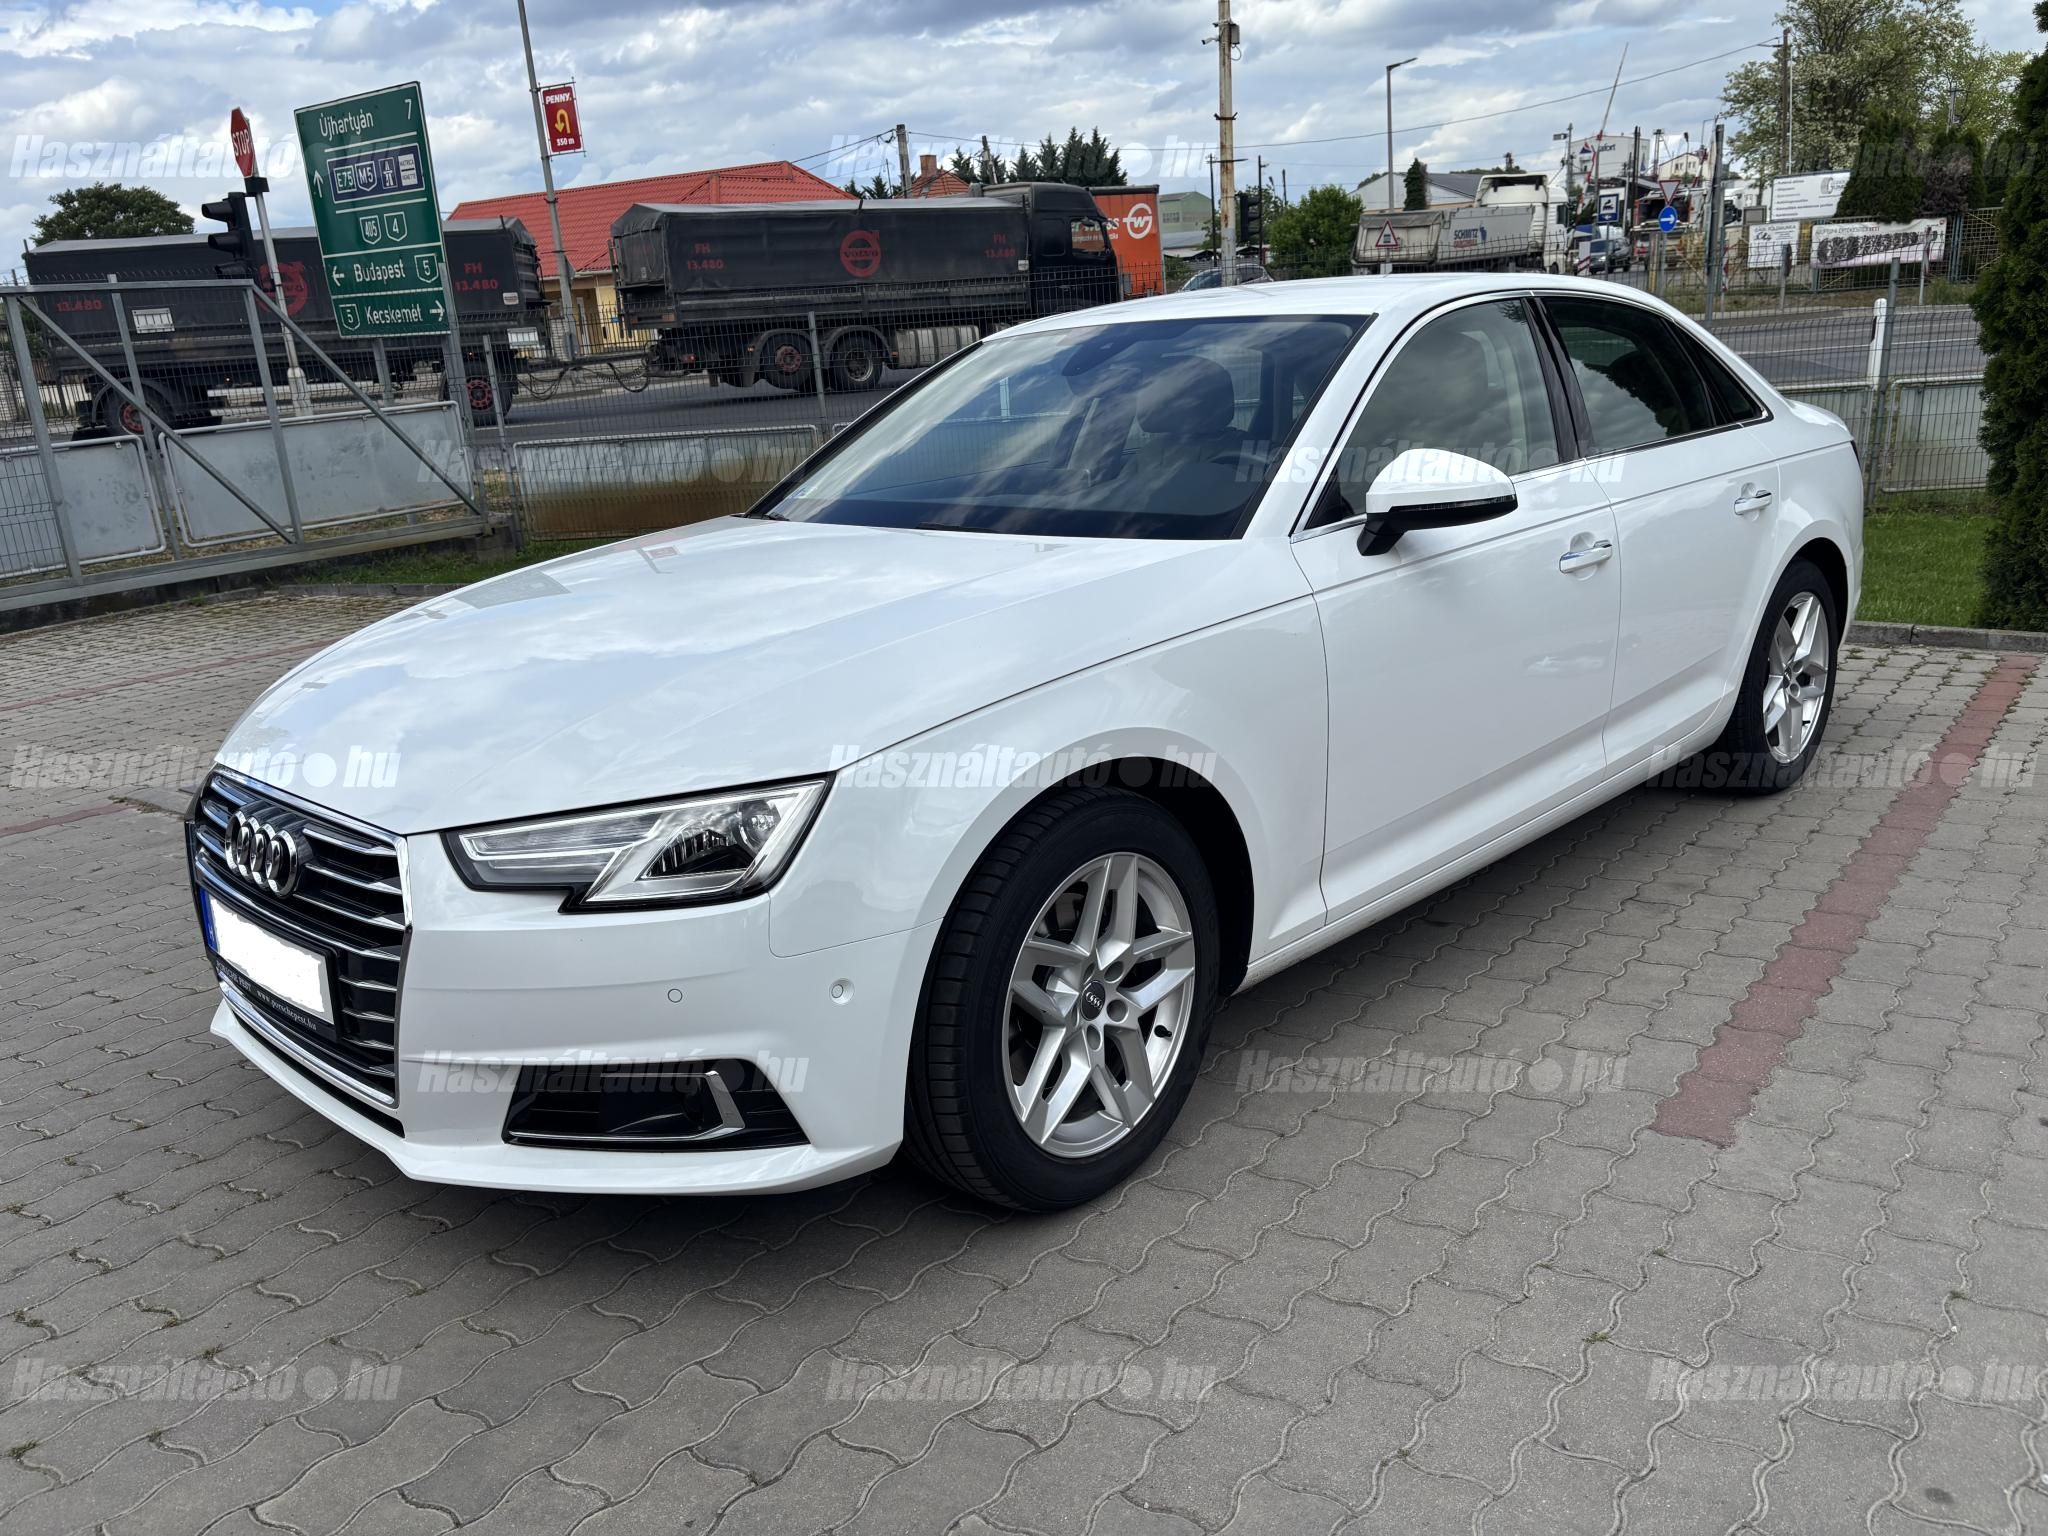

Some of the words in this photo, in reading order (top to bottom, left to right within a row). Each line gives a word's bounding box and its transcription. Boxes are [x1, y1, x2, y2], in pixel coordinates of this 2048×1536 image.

[320, 109, 374, 141] Újhartyán
[404, 99, 412, 120] 7
[232, 129, 250, 157] STOP
[336, 171, 354, 188] E75
[358, 166, 374, 185] M5
[365, 220, 378, 238] 405
[392, 218, 399, 234] 4
[353, 259, 406, 284] Budapest
[422, 260, 431, 276] 5
[464, 263, 483, 274] FH
[346, 309, 354, 323] 5
[365, 304, 423, 324] Kecskemét
